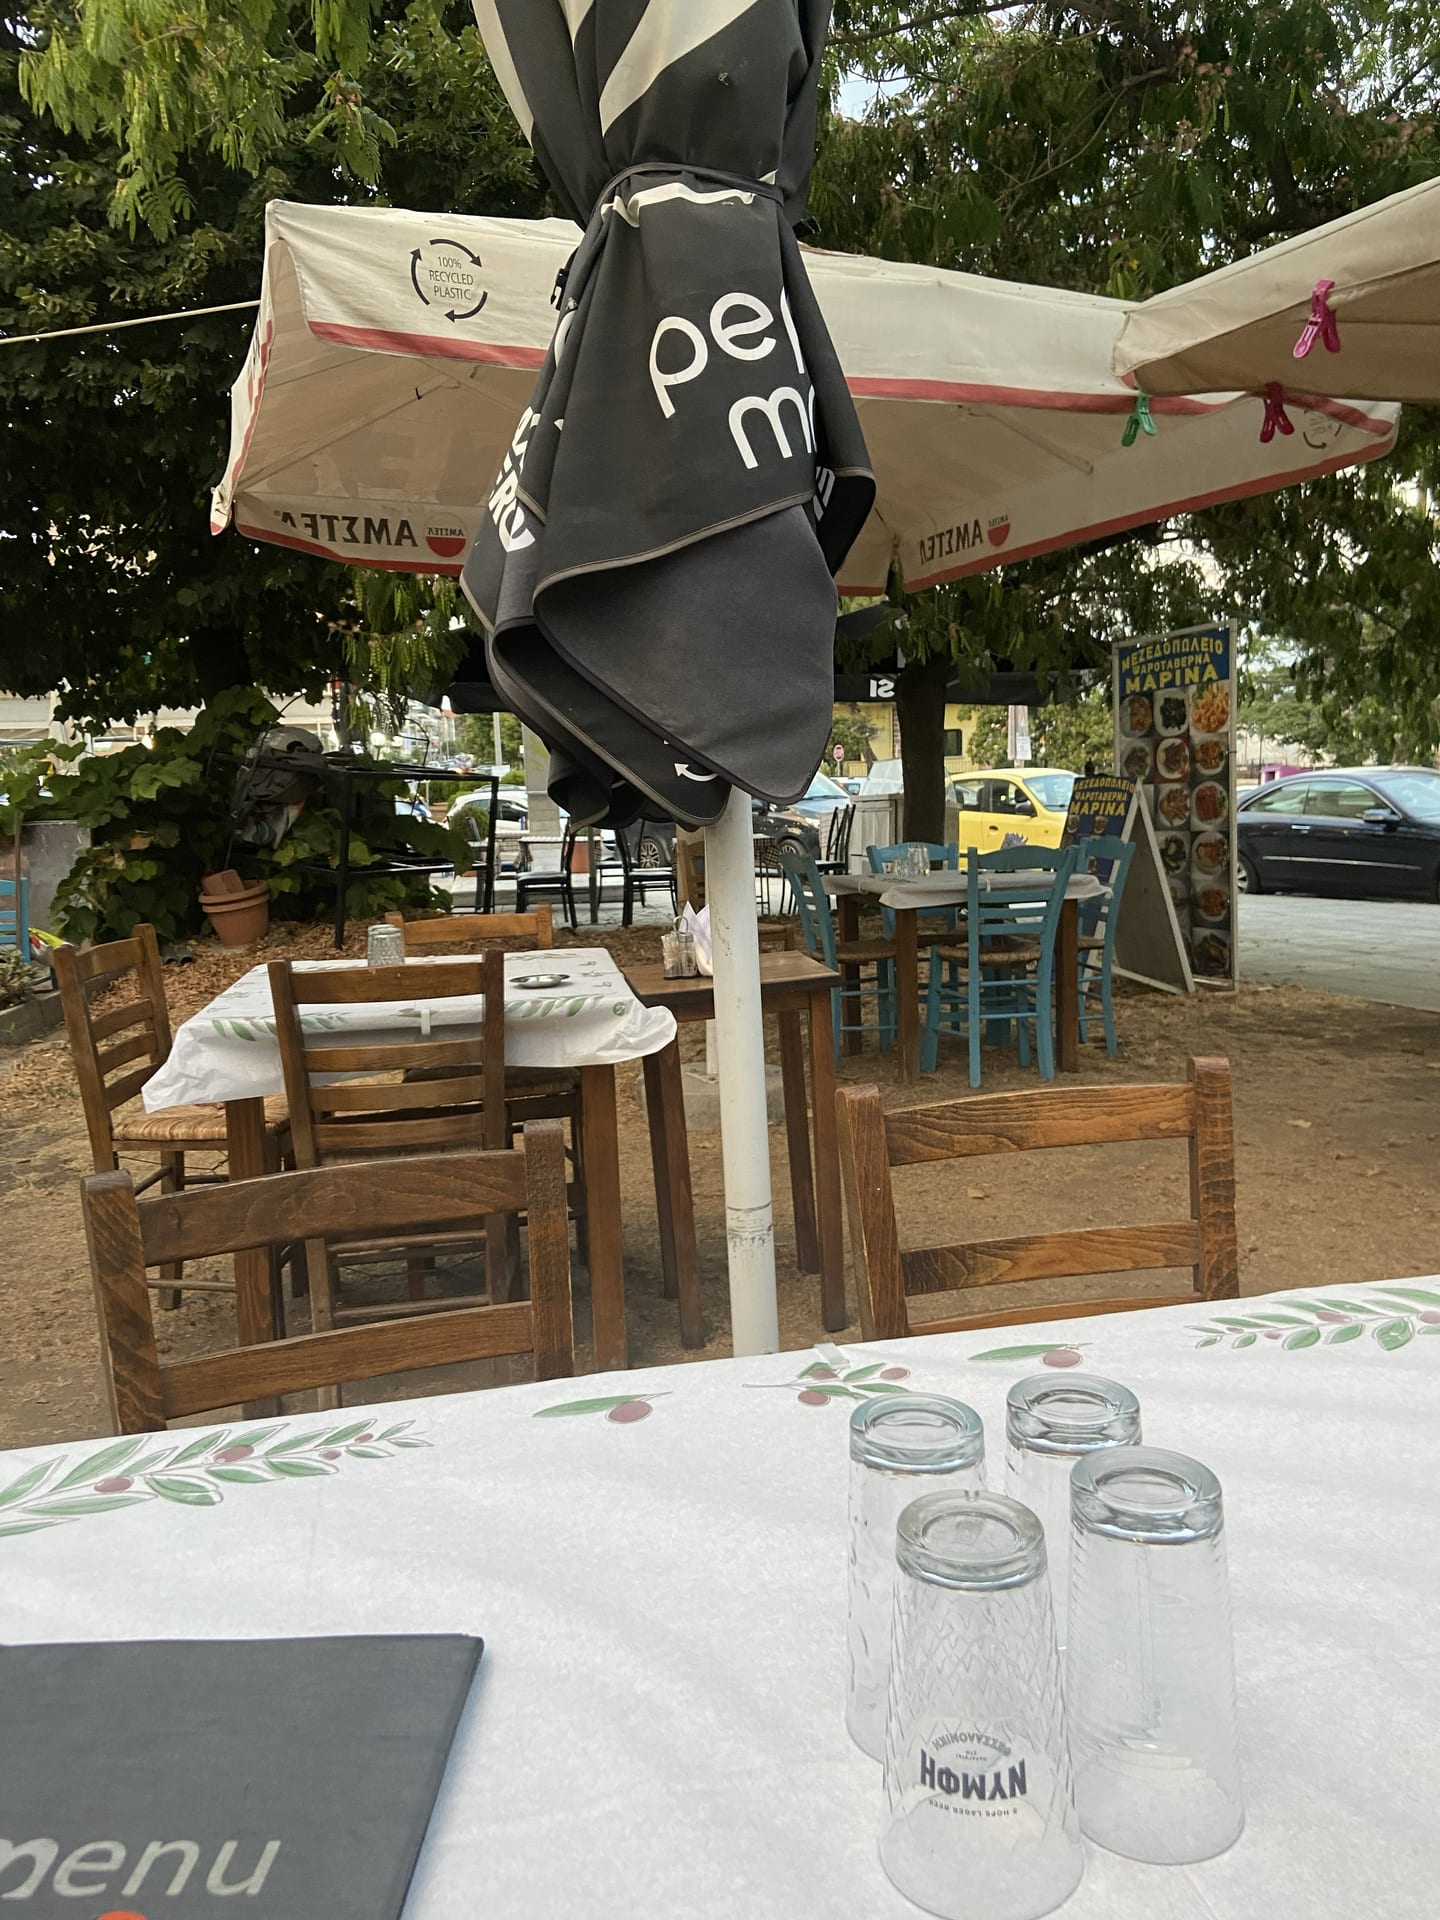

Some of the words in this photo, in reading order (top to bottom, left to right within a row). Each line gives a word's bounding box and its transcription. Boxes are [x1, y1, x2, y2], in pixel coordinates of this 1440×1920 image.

[438, 256, 462, 269] 100%
[429, 270, 474, 286] RECYCLED
[433, 285, 472, 301] PLASTIC
[1125, 663, 1219, 695] ΜΑΡΙΝΑ
[1069, 801, 1126, 816] ΜΑΡΙΝΑ
